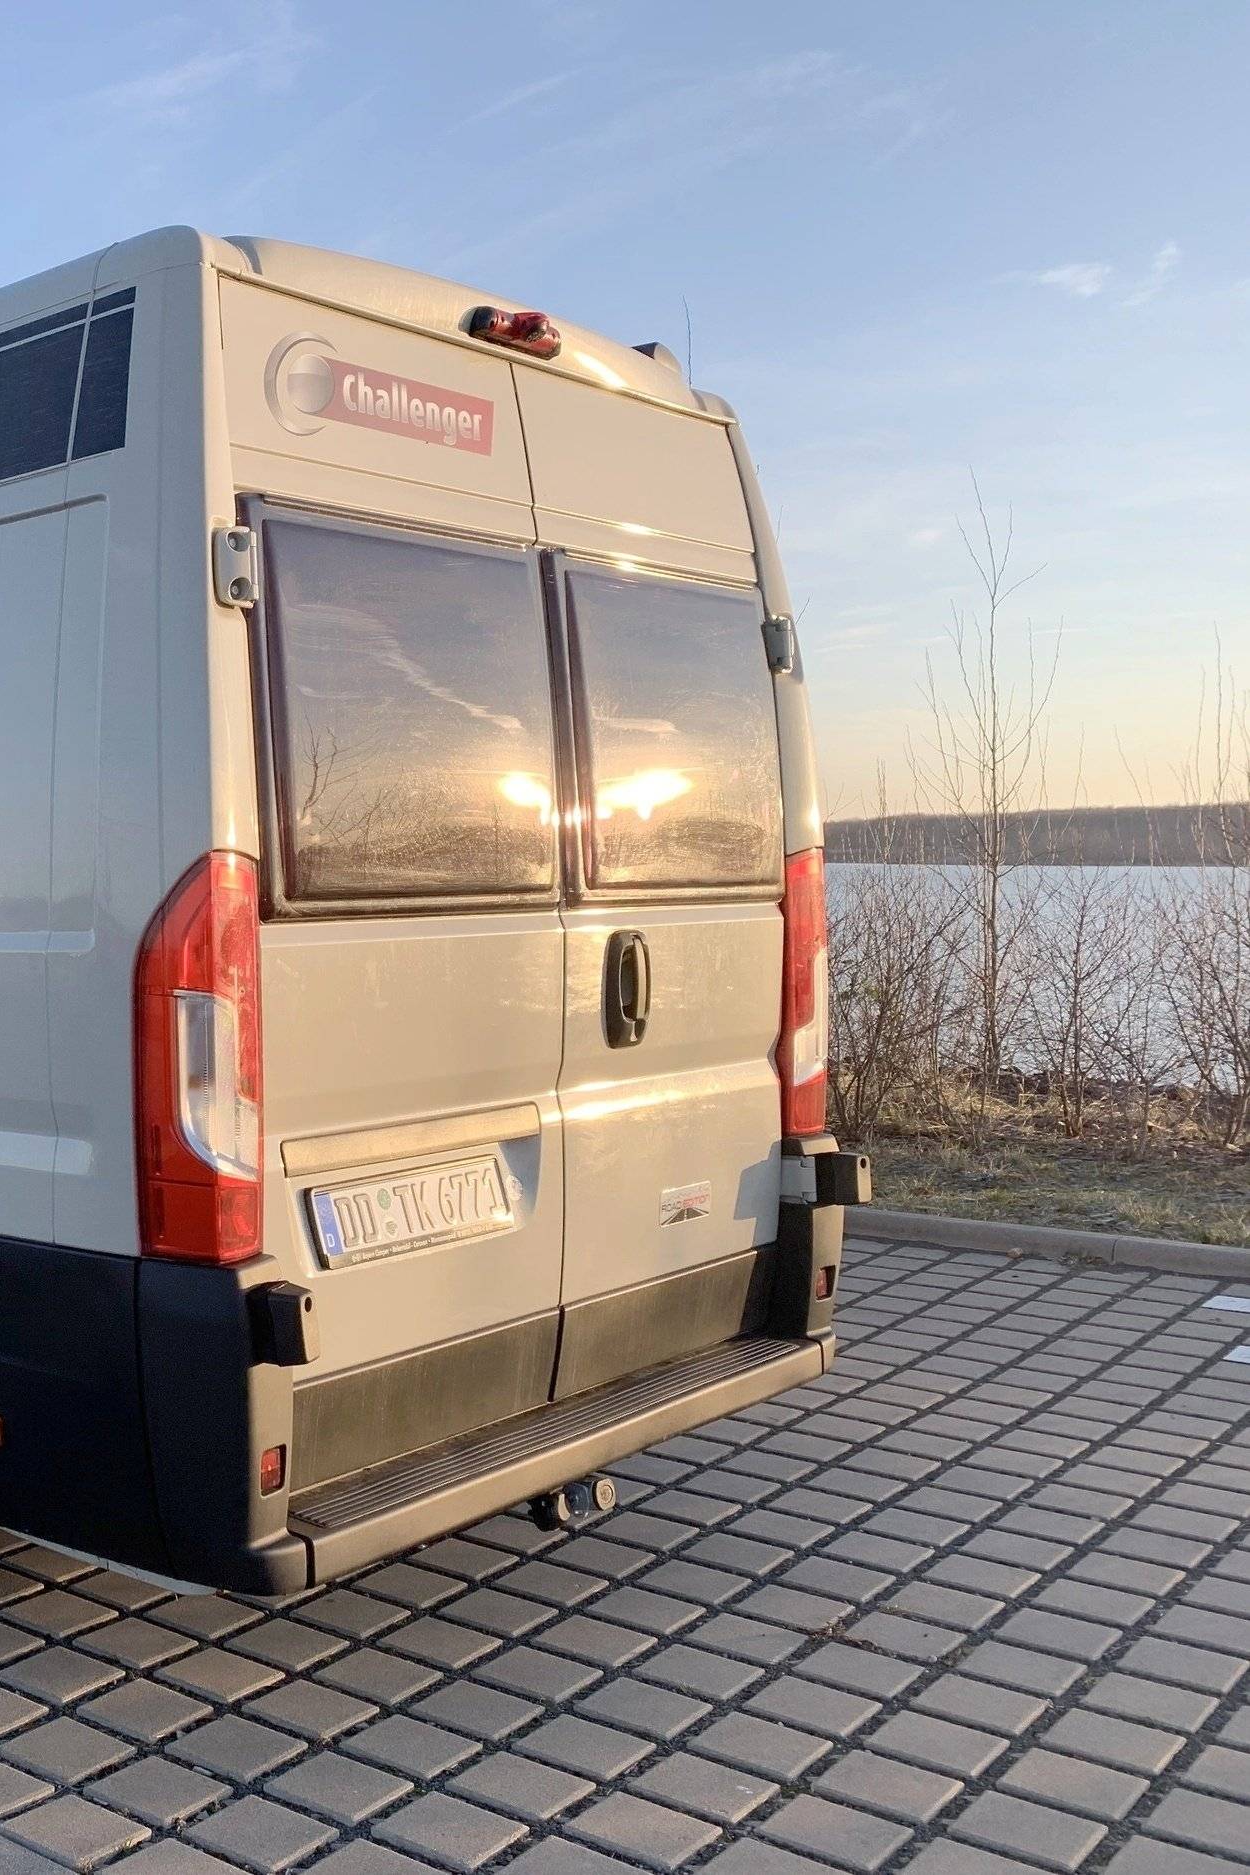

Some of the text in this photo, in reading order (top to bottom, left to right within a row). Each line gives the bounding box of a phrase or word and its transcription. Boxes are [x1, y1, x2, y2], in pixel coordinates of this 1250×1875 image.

[343, 372, 483, 446] Challenger
[327, 1234, 335, 1248] D
[334, 1168, 507, 1248] DD TK 6771
